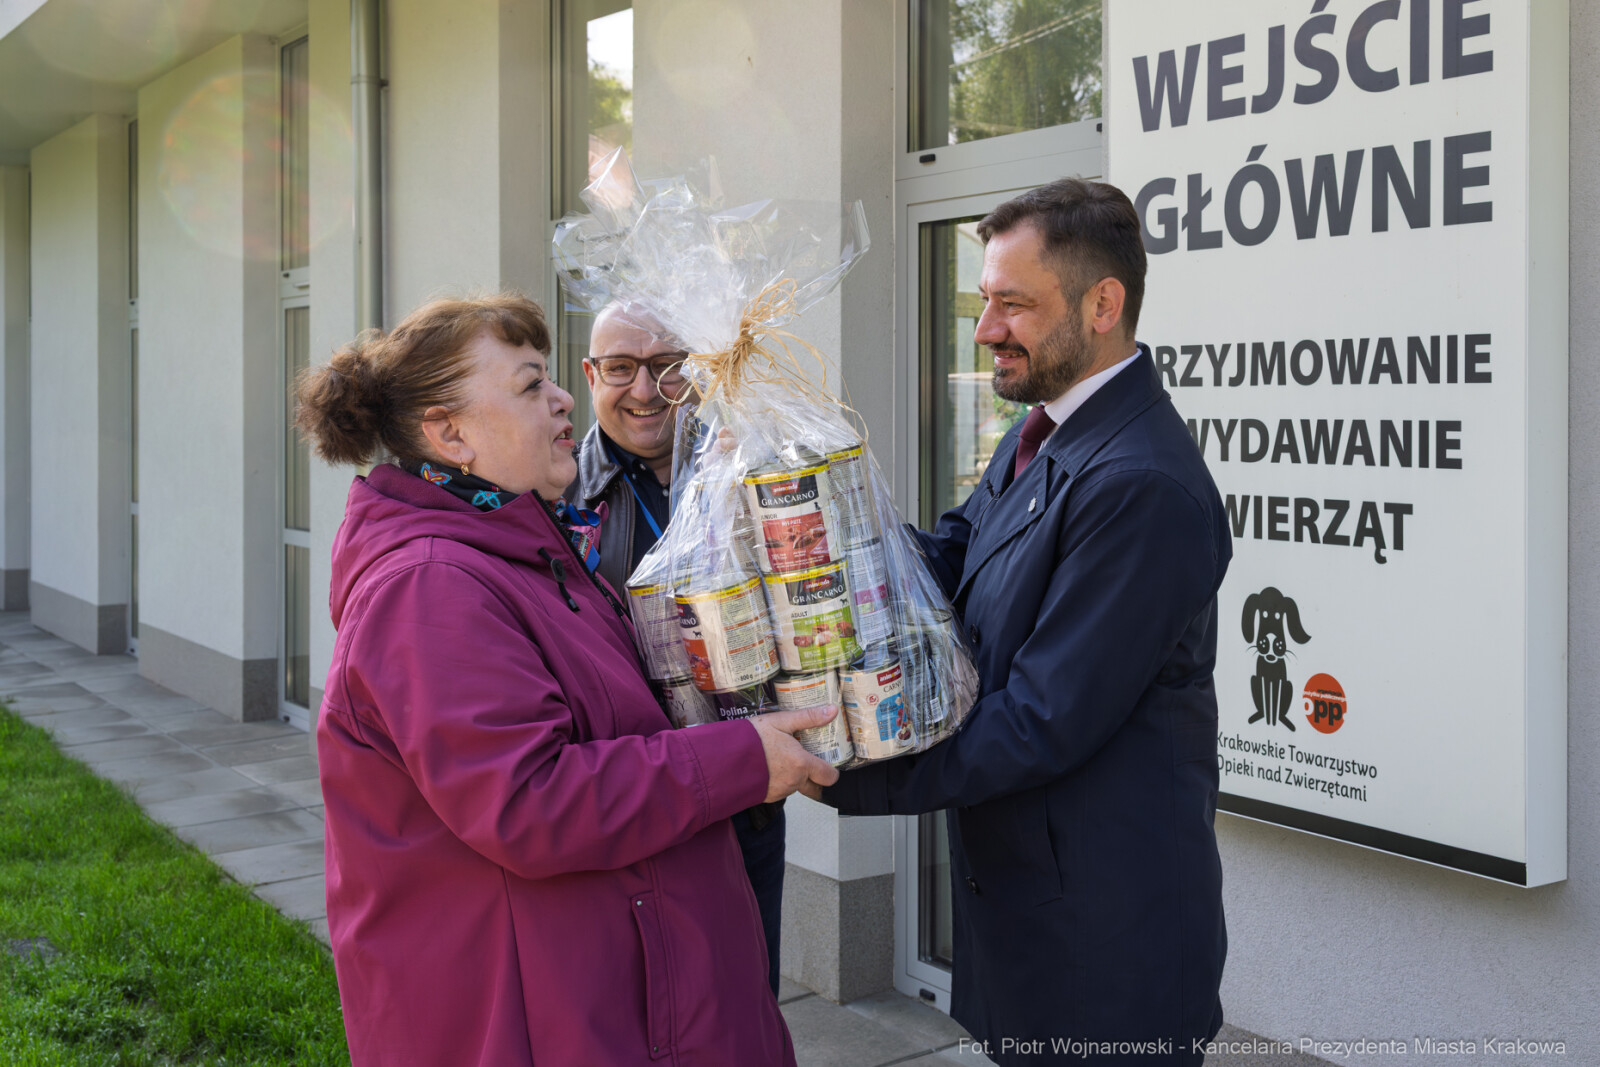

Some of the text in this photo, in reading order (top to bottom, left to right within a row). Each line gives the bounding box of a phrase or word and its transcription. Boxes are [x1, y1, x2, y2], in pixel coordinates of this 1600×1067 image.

[1132, 0, 1494, 133] WEJŚCIE
[1133, 130, 1493, 255] GŁÓWNE
[1155, 333, 1493, 388] RZYJMOWANIE
[1225, 494, 1414, 565] WIERZĄT
[720, 706, 749, 717] Dolina
[1217, 731, 1378, 778] Krakowskie Towarzystwo
[1217, 754, 1367, 802] Opieki nad Zwierzętami
